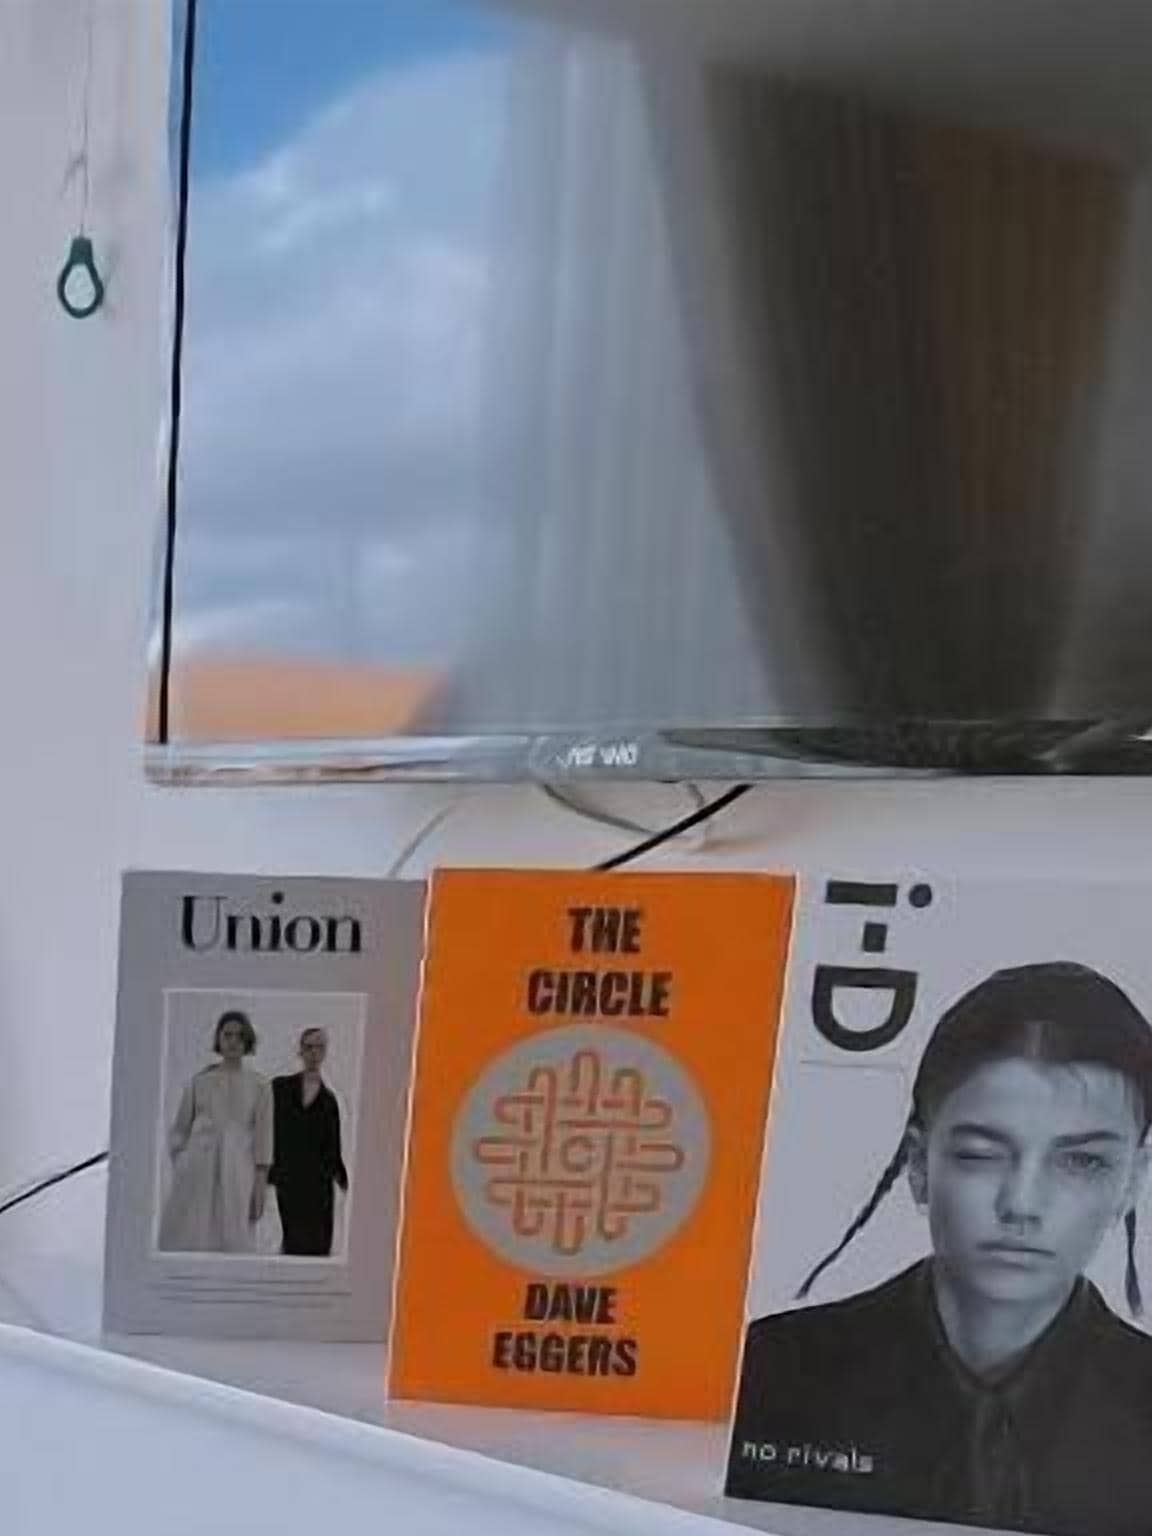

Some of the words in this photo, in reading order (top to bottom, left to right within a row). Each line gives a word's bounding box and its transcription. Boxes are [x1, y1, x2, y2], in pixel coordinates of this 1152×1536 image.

[180, 892, 362, 953] Union
[568, 907, 644, 954] THE
[527, 969, 672, 1017] CIRCLE
[524, 1283, 617, 1325] DAVE
[493, 1332, 638, 1376] EGGERS
[741, 1441, 778, 1461] no
[787, 1443, 875, 1473] rivals
